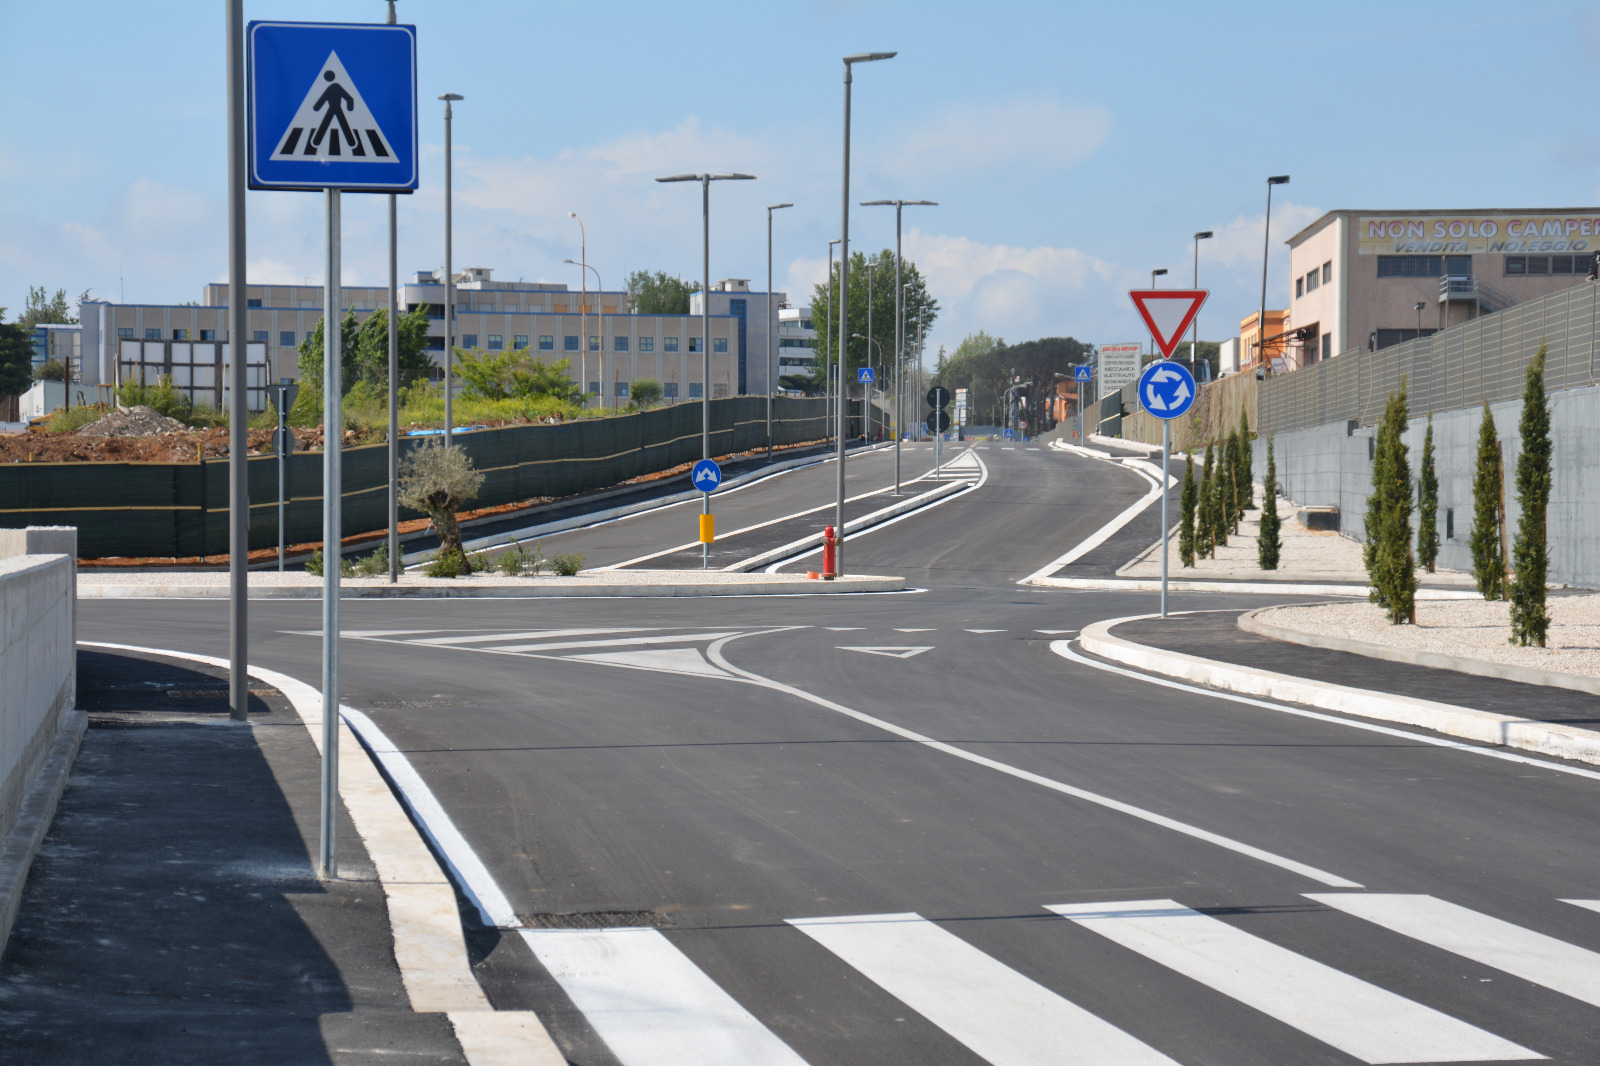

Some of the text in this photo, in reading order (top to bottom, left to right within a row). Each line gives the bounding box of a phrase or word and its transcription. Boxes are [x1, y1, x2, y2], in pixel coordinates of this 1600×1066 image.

[1369, 220, 1424, 238] NON
[1433, 219, 1498, 238] SOLO
[1395, 241, 1469, 253] VENDITA
[1488, 239, 1588, 252] NOLEGGIO
